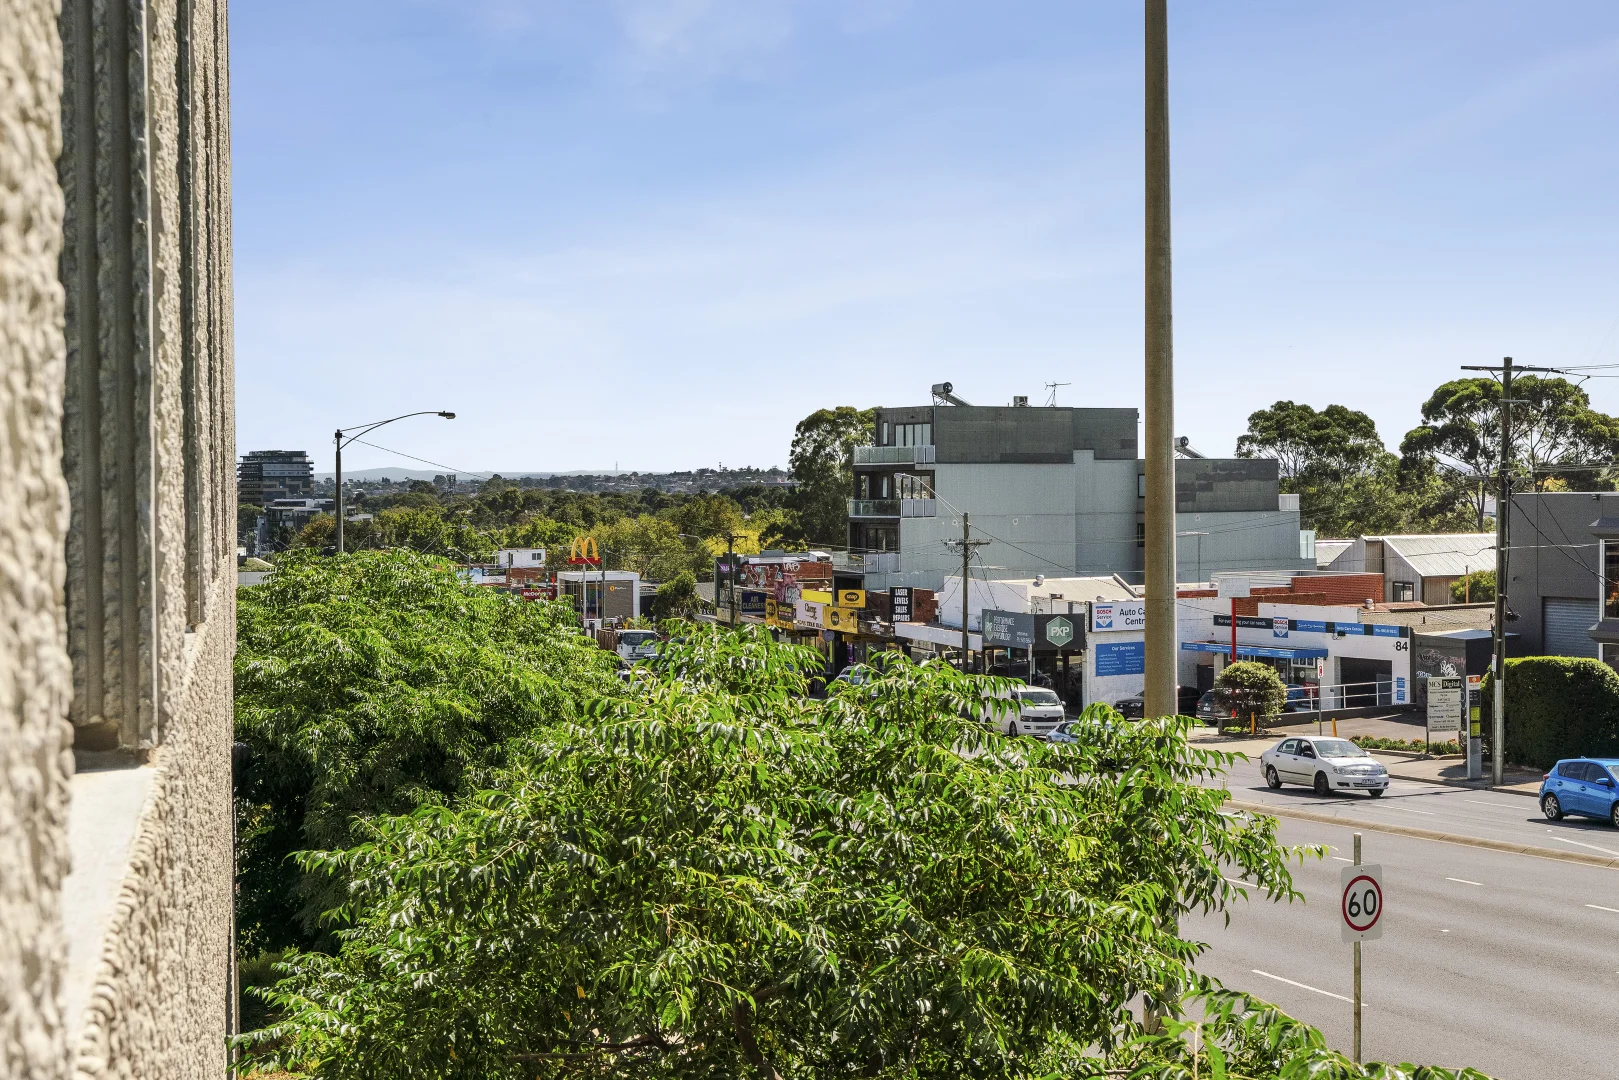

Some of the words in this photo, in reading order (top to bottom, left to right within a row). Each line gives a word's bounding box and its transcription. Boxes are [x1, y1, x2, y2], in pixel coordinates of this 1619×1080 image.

[895, 588, 908, 596] LASER
[894, 597, 909, 605] LEVELS
[1119, 608, 1136, 616] Auto
[892, 614, 910, 622] REPAIRS
[1125, 617, 1145, 625] Centr
[1050, 626, 1070, 637] PXP
[1395, 641, 1408, 651] 84
[1429, 680, 1441, 688] MCS
[1442, 680, 1461, 688] Digital
[1348, 888, 1377, 918] 60
